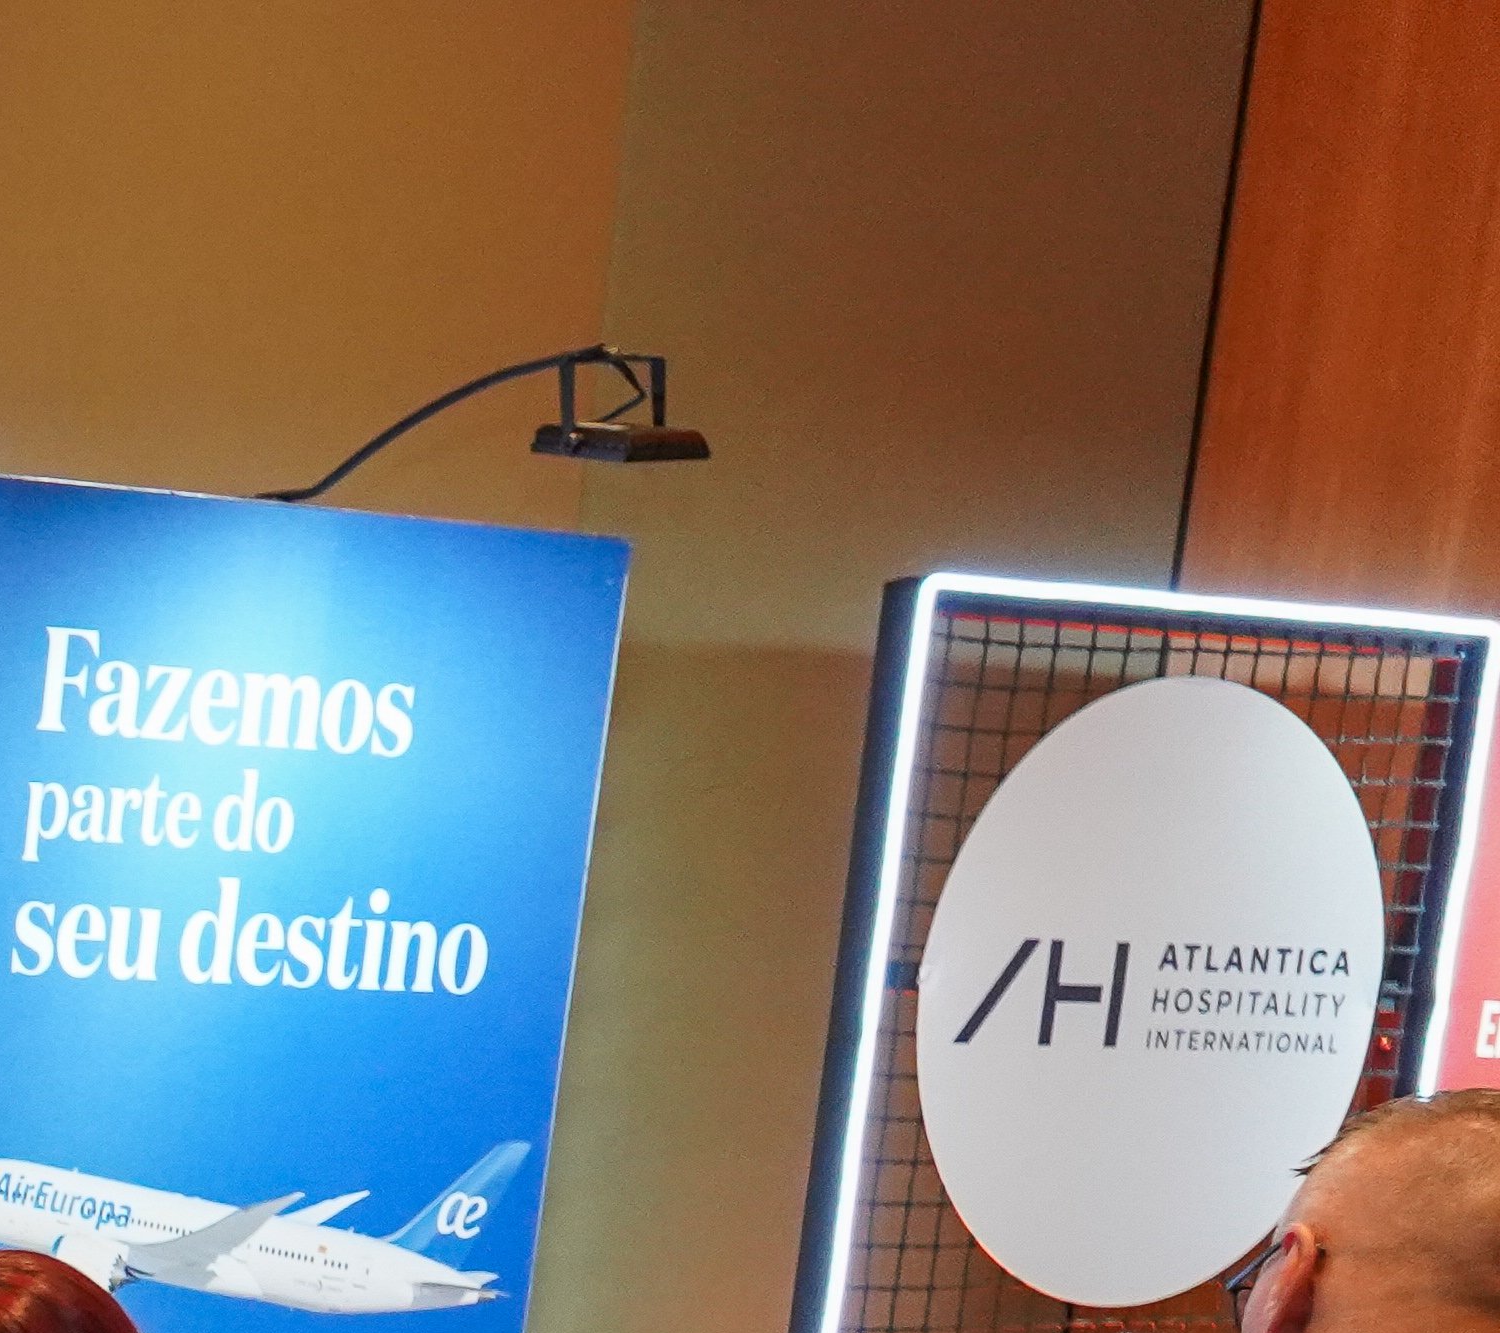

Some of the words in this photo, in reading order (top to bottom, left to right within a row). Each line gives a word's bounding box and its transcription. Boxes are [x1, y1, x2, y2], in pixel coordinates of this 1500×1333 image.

[36, 625, 416, 758] Fazemos
[21, 775, 202, 862] parte
[213, 769, 295, 854] do
[11, 898, 159, 982] seu
[179, 877, 489, 996] destino
[1157, 942, 1350, 976] ATLANTICA
[1151, 988, 1346, 1018] HOSPITALITY
[1145, 1028, 1338, 1055] INTERNATIONAL
